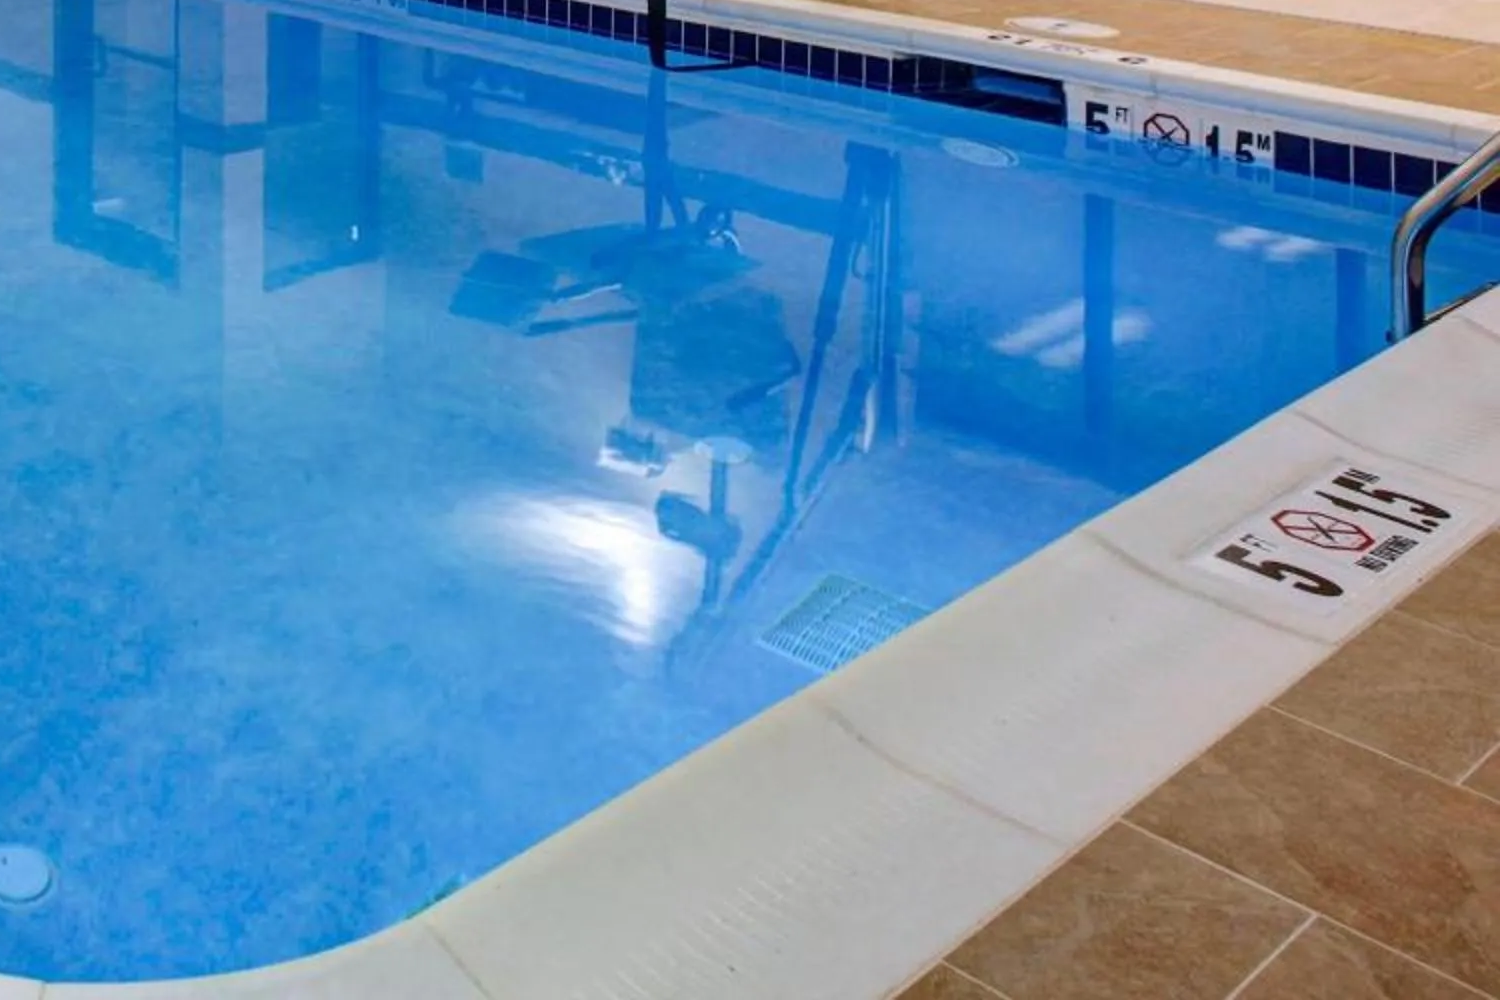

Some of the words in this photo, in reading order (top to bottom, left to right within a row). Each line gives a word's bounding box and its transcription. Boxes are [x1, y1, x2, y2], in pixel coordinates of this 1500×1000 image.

[1085, 100, 1111, 135] 5
[1115, 106, 1128, 124] FT
[1257, 133, 1271, 152] M
[1214, 543, 1345, 597] 5
